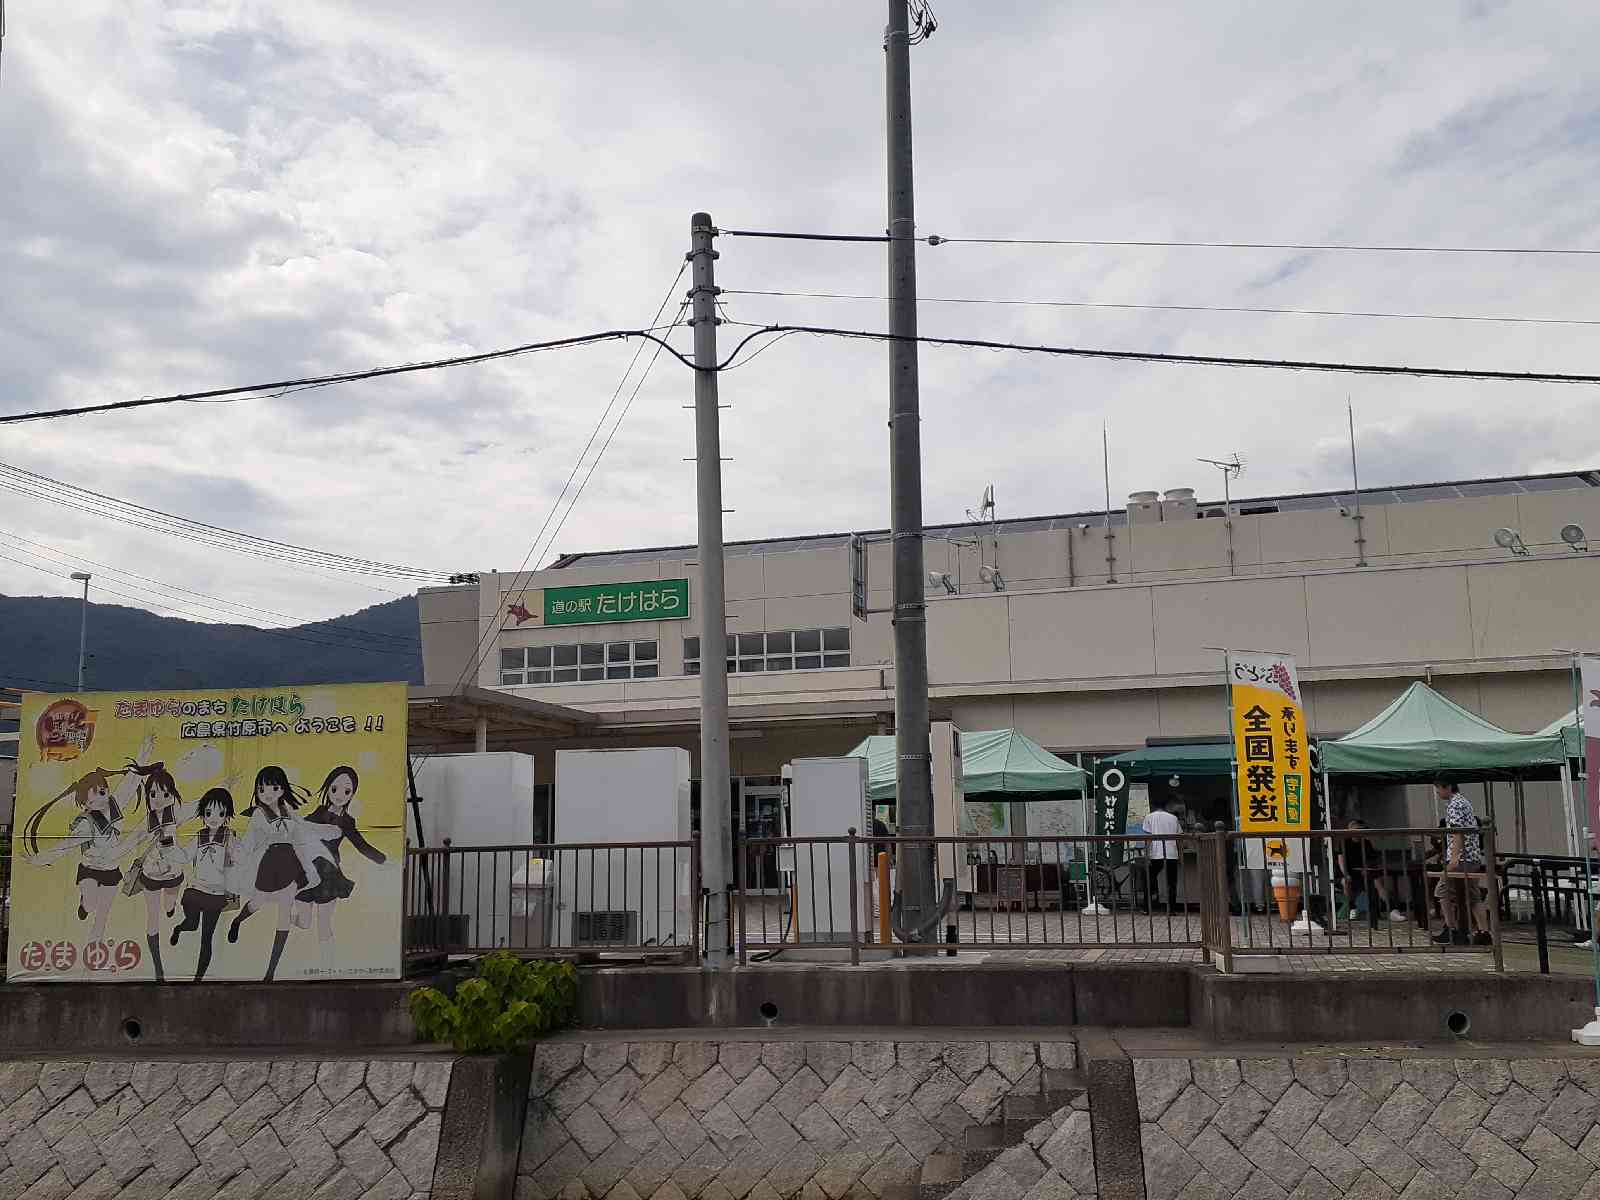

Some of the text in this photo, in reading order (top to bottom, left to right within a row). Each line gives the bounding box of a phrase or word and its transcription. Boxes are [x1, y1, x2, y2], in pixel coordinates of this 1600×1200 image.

[552, 588, 680, 615] 道の駅 たけはら
[115, 697, 227, 718] たまゆらのまち
[181, 718, 287, 740] 広島県竹原市へ
[295, 715, 356, 734] ようこそ
[20, 940, 141, 972] たまゆら
